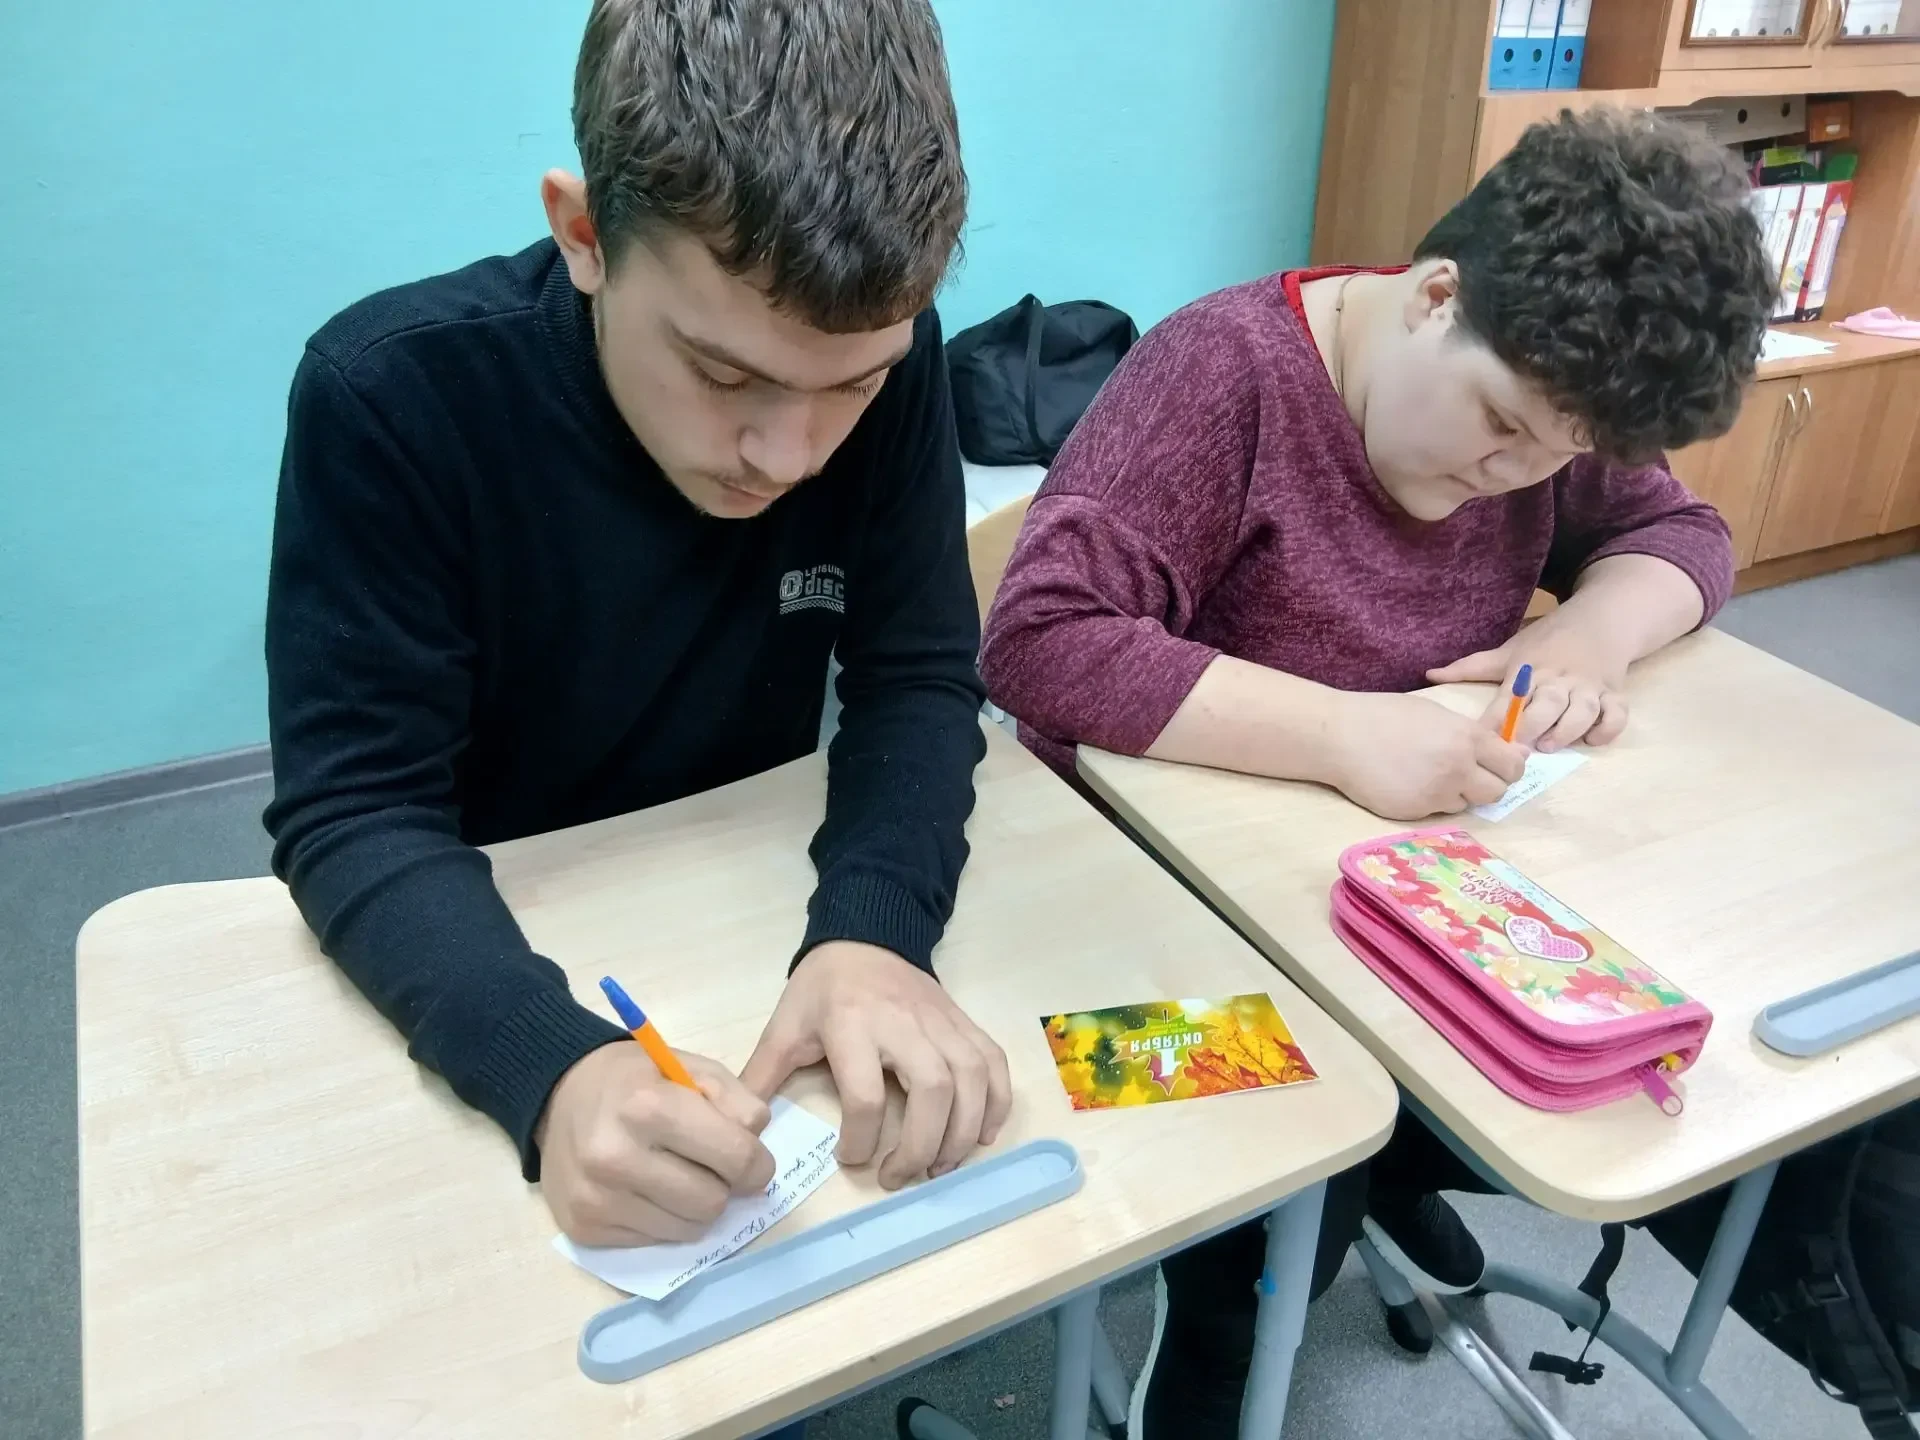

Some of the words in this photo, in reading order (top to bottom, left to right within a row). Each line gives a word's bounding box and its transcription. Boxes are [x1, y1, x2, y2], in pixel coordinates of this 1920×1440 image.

[1460, 882, 1505, 905] DAY
[1130, 1032, 1203, 1053] ОКТЯБРЯ
[1156, 1048, 1183, 1077] 1
